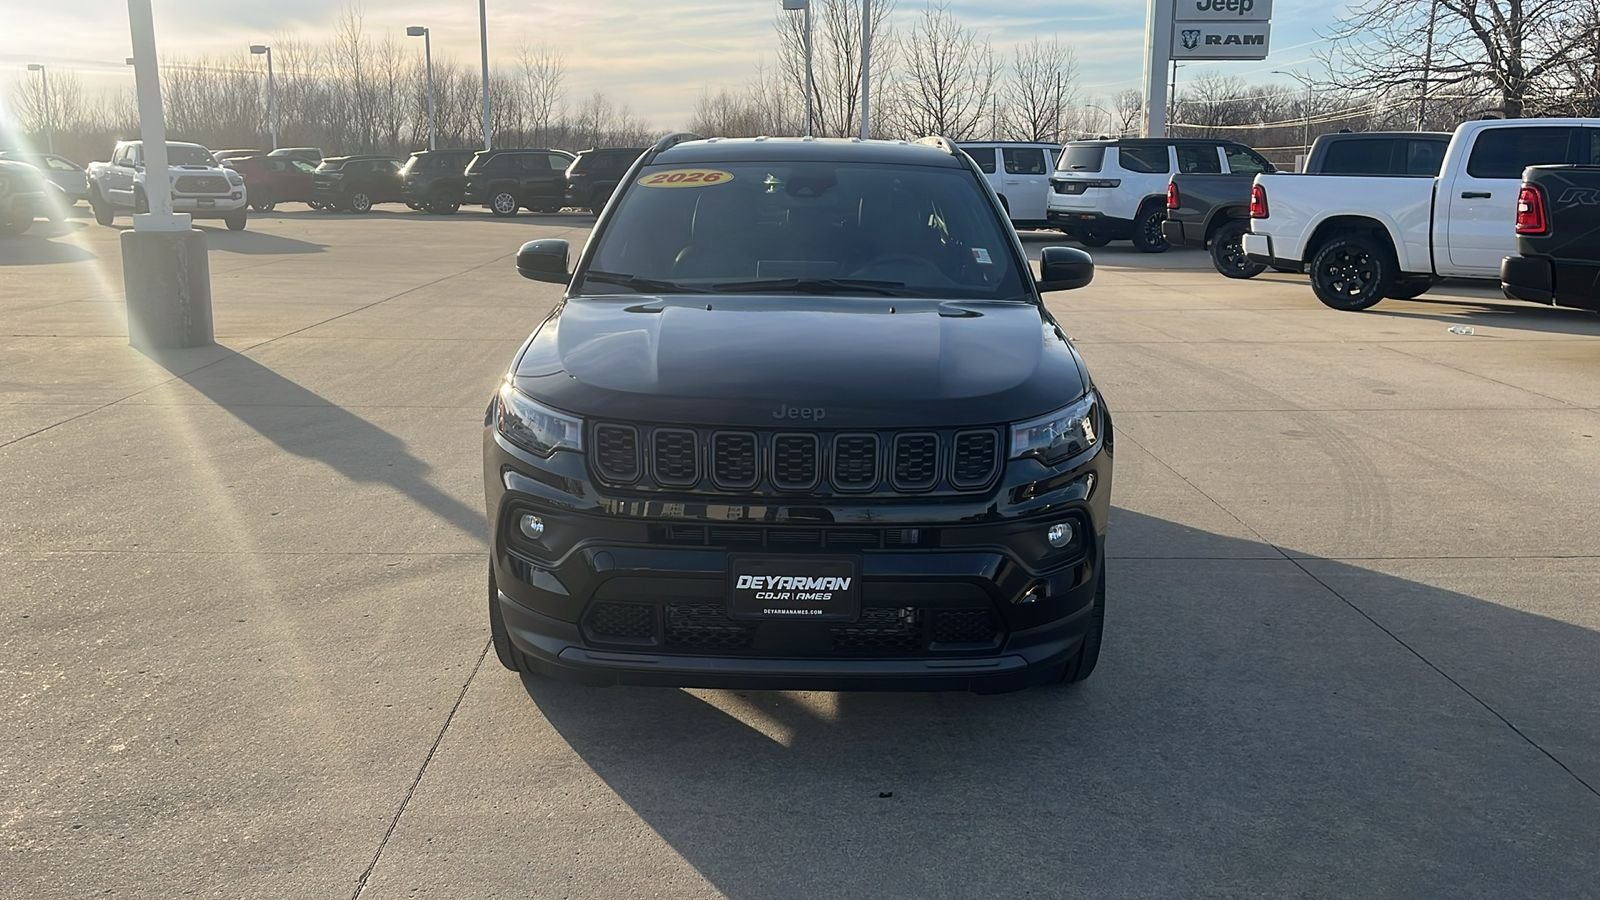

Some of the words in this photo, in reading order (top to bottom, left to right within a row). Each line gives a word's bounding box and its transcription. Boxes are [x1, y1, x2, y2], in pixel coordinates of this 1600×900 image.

[1196, 0, 1254, 15] Jeep
[1205, 35, 1265, 45] RAM
[647, 172, 723, 185] 2026
[772, 403, 826, 422] Jeep
[736, 575, 851, 590] DEYARMAN
